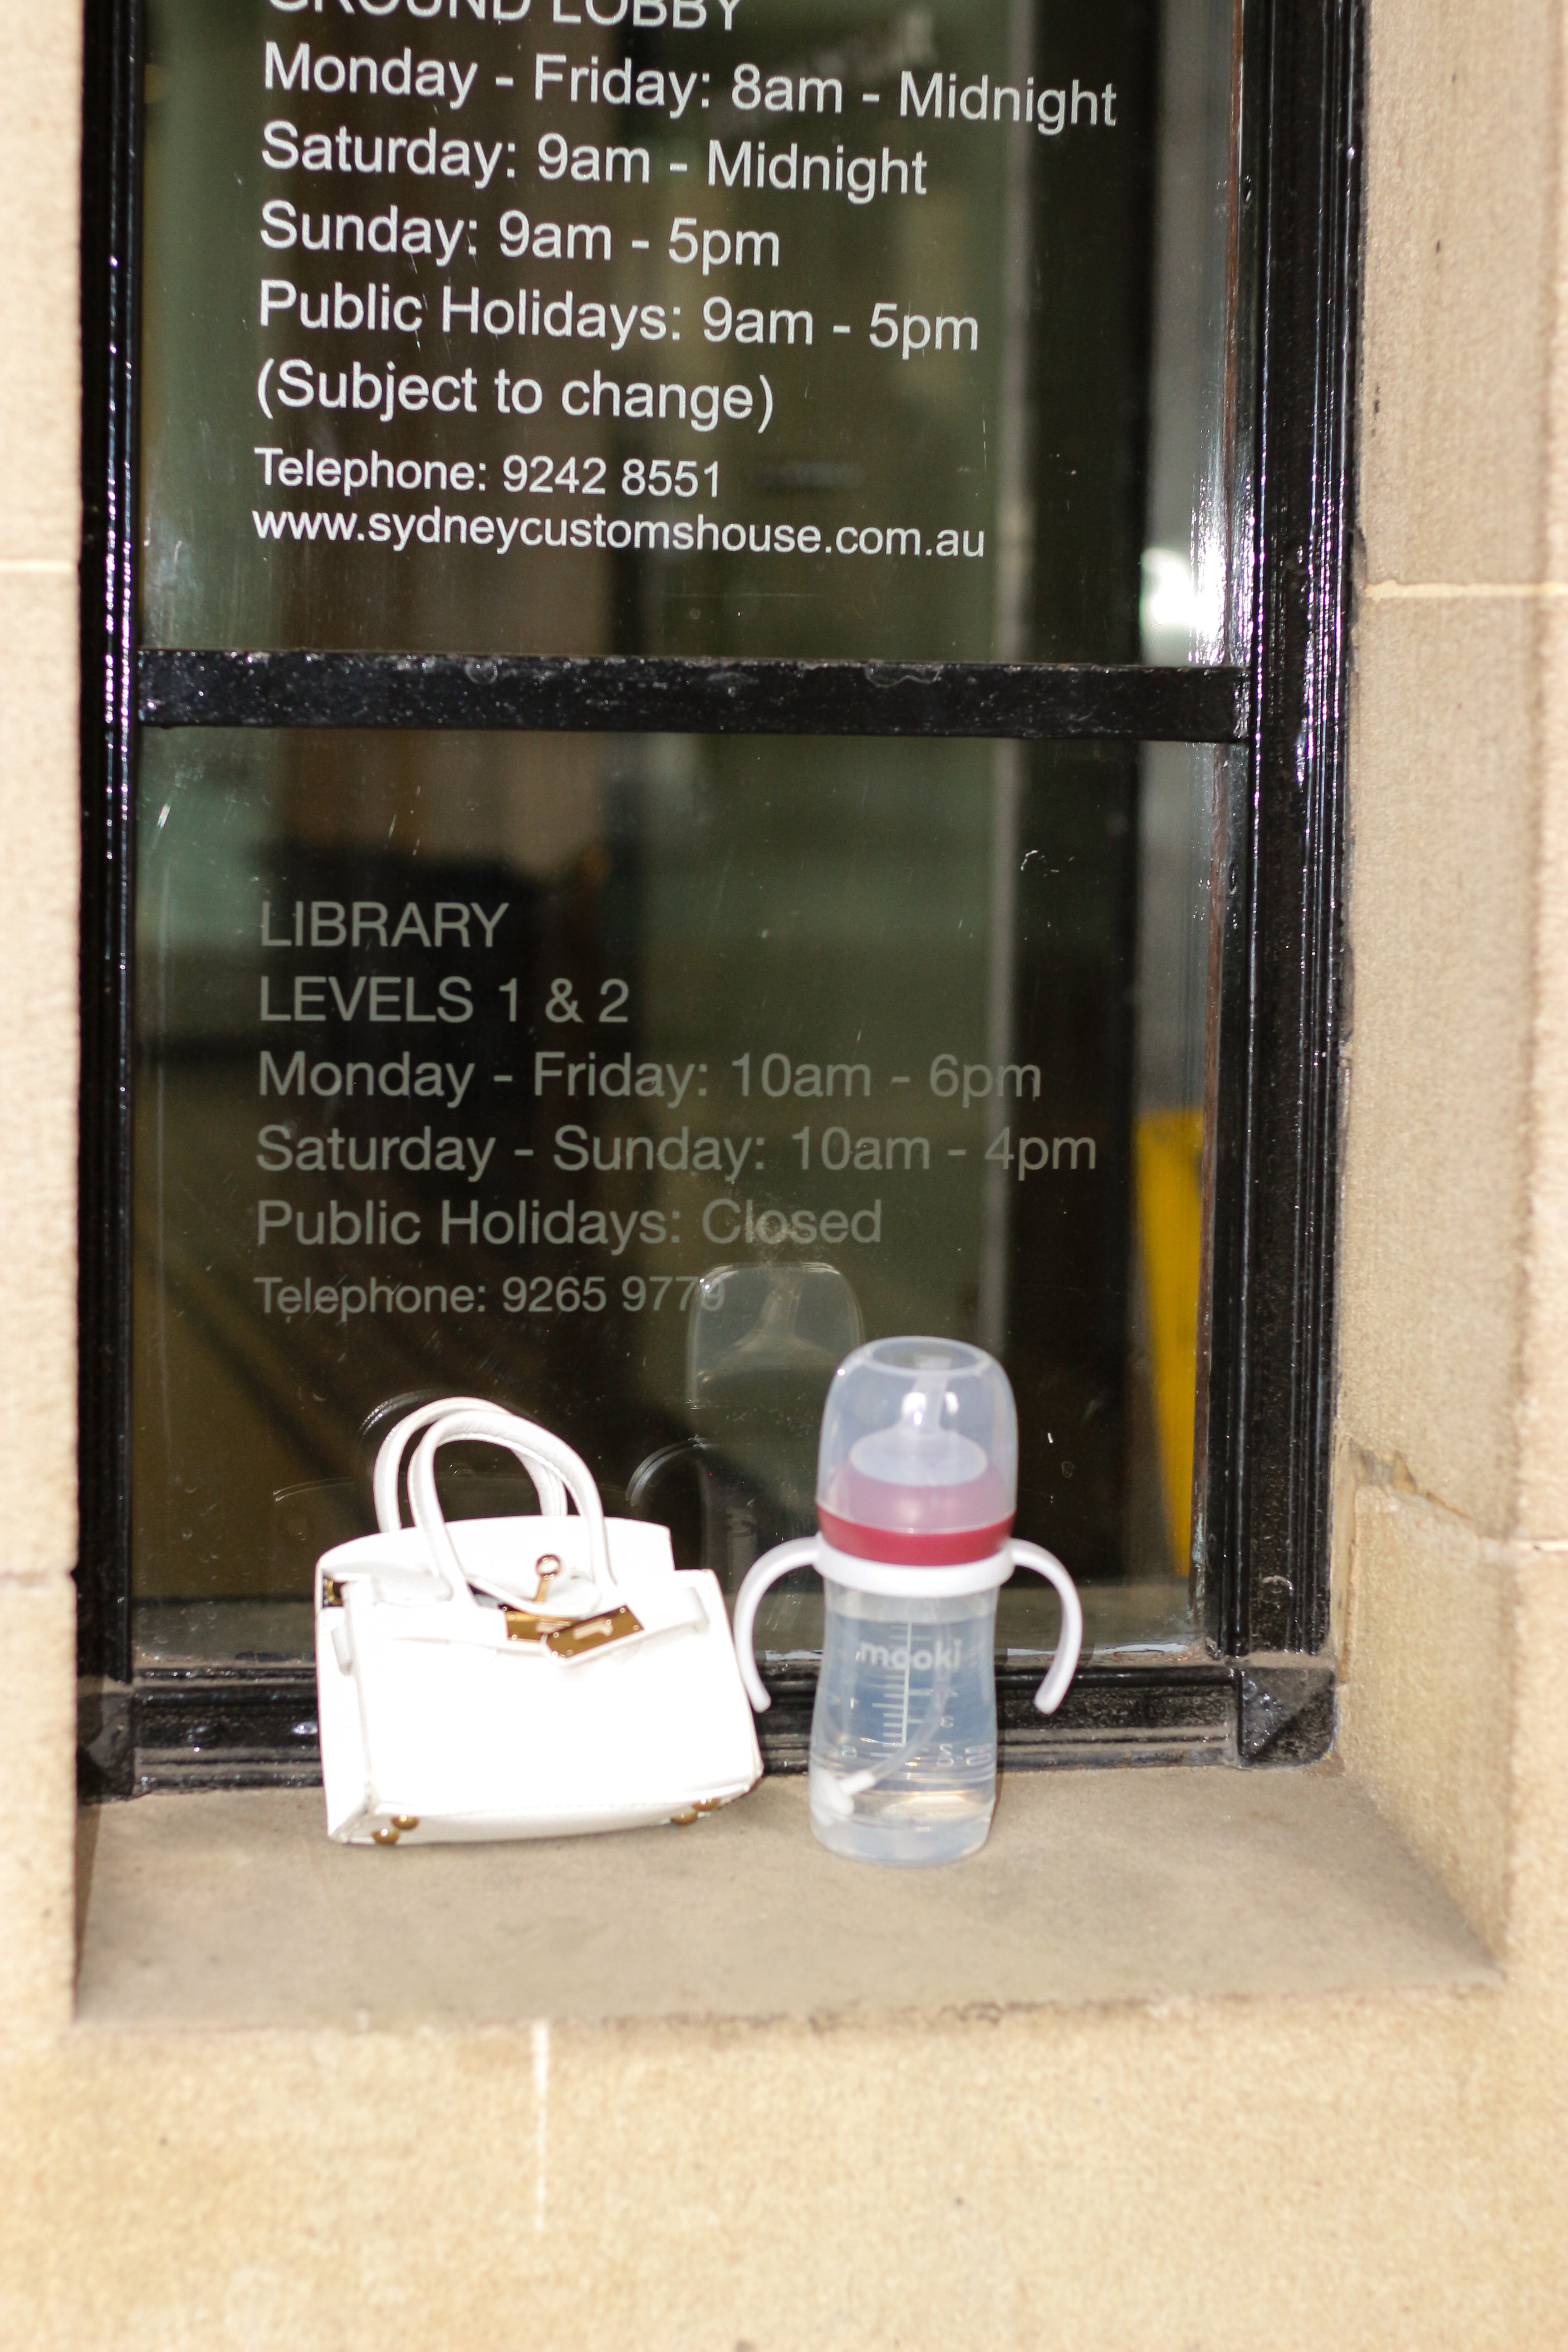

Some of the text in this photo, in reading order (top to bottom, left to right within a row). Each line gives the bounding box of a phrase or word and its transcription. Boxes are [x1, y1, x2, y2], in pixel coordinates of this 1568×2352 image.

[265, 41, 1117, 136] Monday - Friday: 8am - Midnight
[261, 120, 927, 205] Saturday: 9am - Midnight
[260, 200, 779, 276] Sunday: 9am - 5pm
[260, 279, 978, 360] Public Holidays: 9am - 5pm
[257, 358, 774, 434] (Subject to change)
[254, 447, 718, 498] Telephone: 9242 8551
[251, 505, 985, 557] www.sydneycustomshouse.com.au
[259, 901, 510, 948] LIBRARY
[259, 975, 629, 1024] LEVELS 1 & 2
[259, 1050, 475, 1109] Monday
[493, 1074, 513, 1083] -
[534, 1051, 708, 1109] Friday:
[732, 1053, 871, 1097] 10am
[930, 1054, 1041, 1108] 6pm
[256, 1124, 496, 1183] Saturday
[553, 1124, 764, 1185] Sunday:
[792, 1126, 930, 1170] 10am
[984, 1127, 1096, 1181] 4pm
[257, 1198, 882, 1256] Public Holidays: Closed
[254, 1276, 486, 1321] Telephone:
[502, 1276, 606, 1313] 9265
[860, 1637, 963, 1672] mooki
